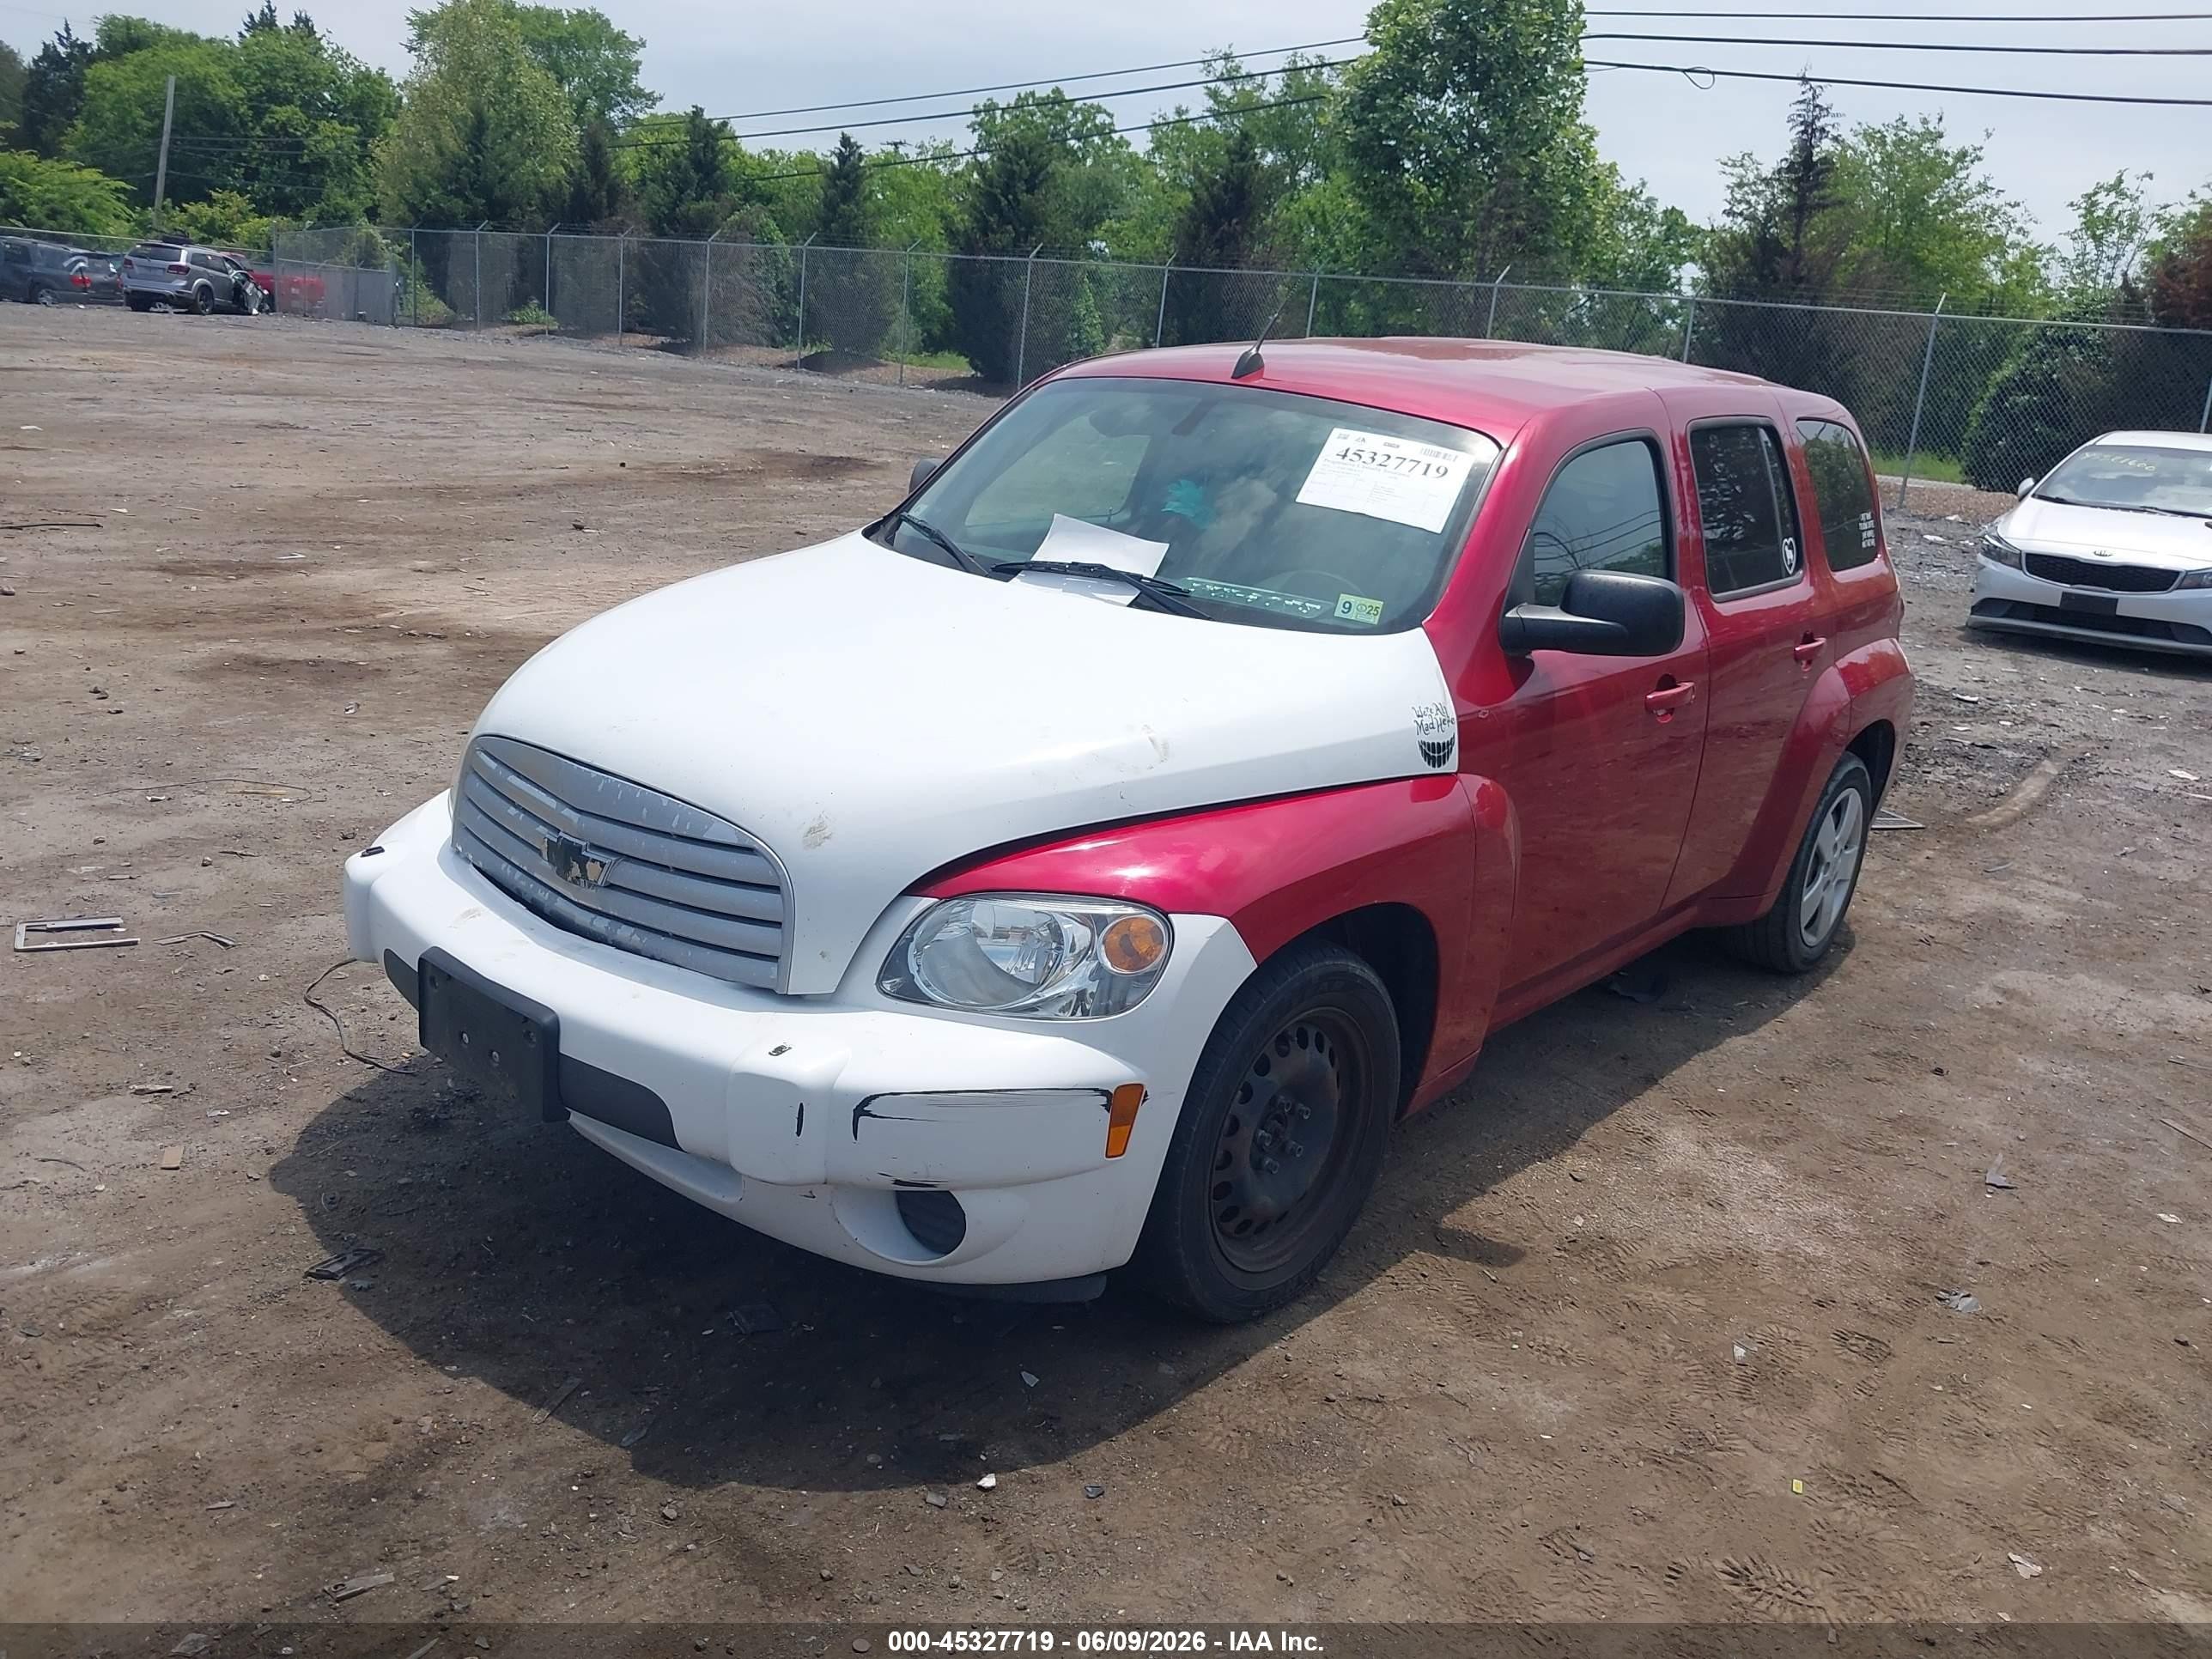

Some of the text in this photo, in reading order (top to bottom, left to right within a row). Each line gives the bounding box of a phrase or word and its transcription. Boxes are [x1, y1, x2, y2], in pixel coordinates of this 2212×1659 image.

[1335, 446, 1449, 479] 45327719
[1341, 600, 1381, 617] 9 25
[1413, 714, 1455, 736] Mad Here
